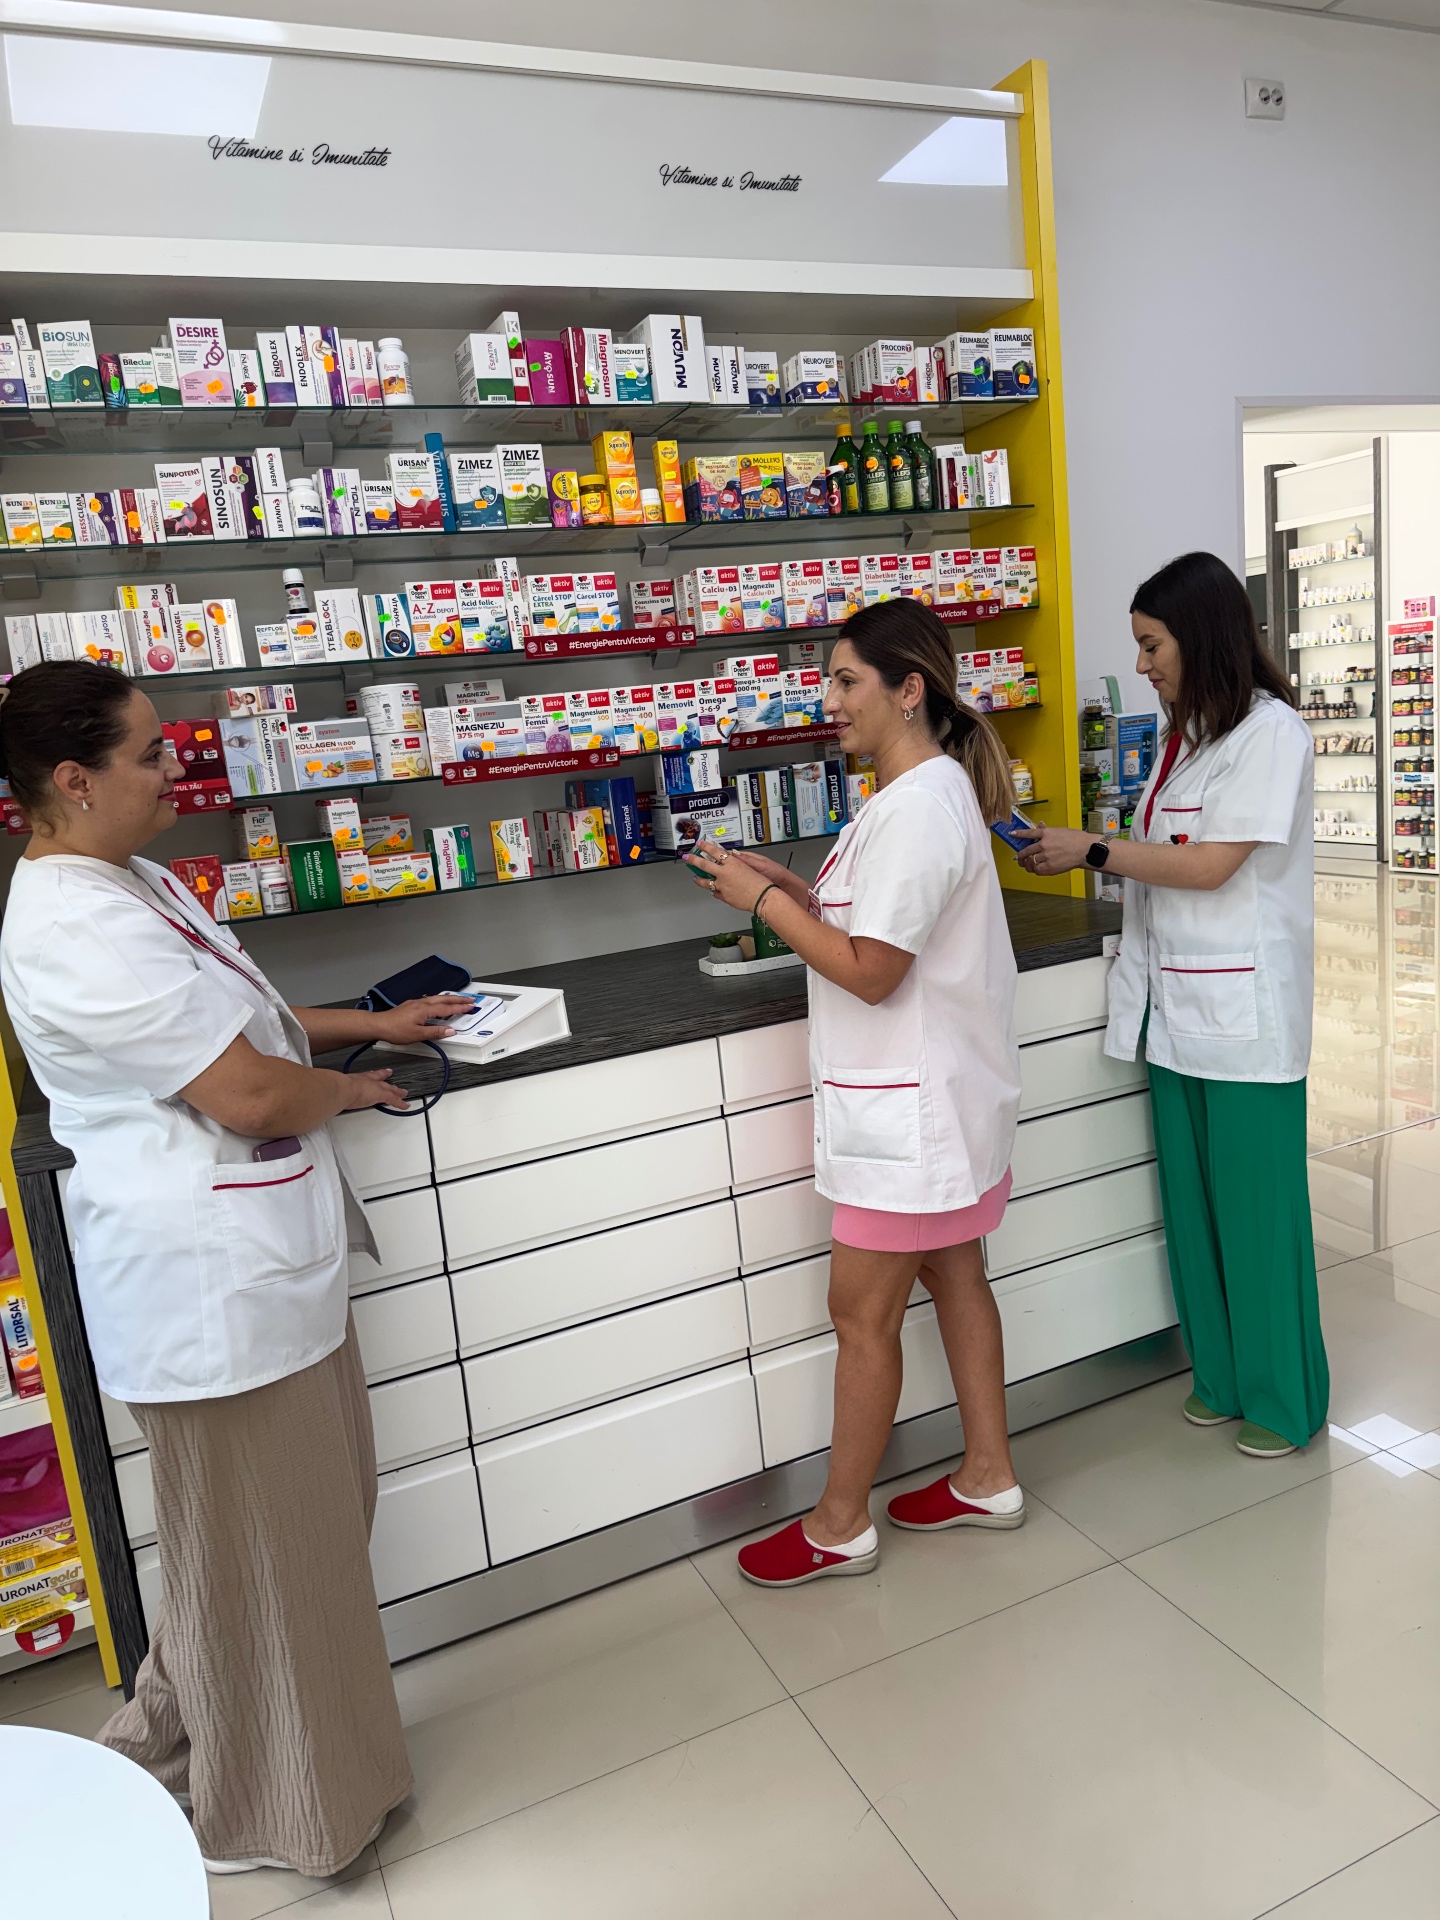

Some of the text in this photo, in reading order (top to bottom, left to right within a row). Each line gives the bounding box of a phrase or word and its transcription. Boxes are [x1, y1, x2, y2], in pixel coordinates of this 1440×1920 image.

[207, 135, 391, 167] Vitamine si Imunitate
[659, 163, 803, 193] Vitamine si Imunitate
[176, 327, 219, 338] DESIRE
[994, 334, 1032, 342] REUMABLOC
[960, 336, 989, 344] REUMABLOC
[269, 340, 282, 378] ENDOLEX
[670, 328, 688, 388] MUVON
[295, 346, 308, 387] ENDOLEX
[598, 334, 611, 398] Magnosun
[712, 358, 722, 392] MUVON
[730, 360, 740, 394] MUVON
[609, 440, 630, 448] Supradyn
[502, 450, 540, 461] ZIMEZ
[458, 460, 493, 470] ZIMEZ
[159, 468, 200, 478] SUNPOTENT
[433, 450, 450, 518] VITALIN PLUS
[210, 468, 230, 529] SINOSUN
[76, 494, 88, 542] STRESSCLEAN
[506, 583, 514, 602] STOP
[742, 582, 774, 590] Magneziu
[174, 611, 186, 652] RHEUMAGEL
[212, 624, 226, 666] RHEUMATABS
[568, 634, 656, 650] #EnergiePentruVictorie
[757, 662, 776, 670] aktiv
[456, 690, 490, 698] MAGNEZIU
[784, 688, 819, 697] Omega-3
[658, 700, 694, 710] Memovit
[698, 696, 726, 705] Omega
[1083, 698, 1100, 706] Time
[570, 708, 608, 718] Magnesium
[614, 705, 646, 714] Magneziu
[638, 711, 653, 720] 400
[700, 704, 721, 714] 3-6-9
[456, 722, 505, 733] MAGNEZIU
[525, 718, 548, 727] Femei
[260, 718, 272, 760] KOLLAGEN
[318, 728, 340, 736] system
[295, 740, 336, 750] KOLLAGEN
[296, 748, 325, 756] CURCUMA
[488, 758, 578, 775] #EnergiePentruVictorie
[700, 752, 710, 788] Prostenal
[752, 778, 760, 804] proenzi
[828, 774, 842, 816] proenzi
[688, 796, 722, 810] proenzi
[252, 816, 266, 824] Fier
[332, 810, 356, 818] Magnesium
[690, 808, 726, 820] COMPLEX
[624, 804, 633, 840] Prostenal
[755, 814, 764, 839] proenzi
[441, 838, 454, 880] MemoPlus
[313, 850, 324, 886] GinkoPrim
[229, 872, 246, 880] Evening
[230, 876, 251, 884] Primrose
[309, 870, 318, 900] AVANTAJOS
[8, 1299, 28, 1348] LITORSAL
[0, 1566, 82, 1602] URONATgold
[22, 1610, 64, 1630] REDUCERE
